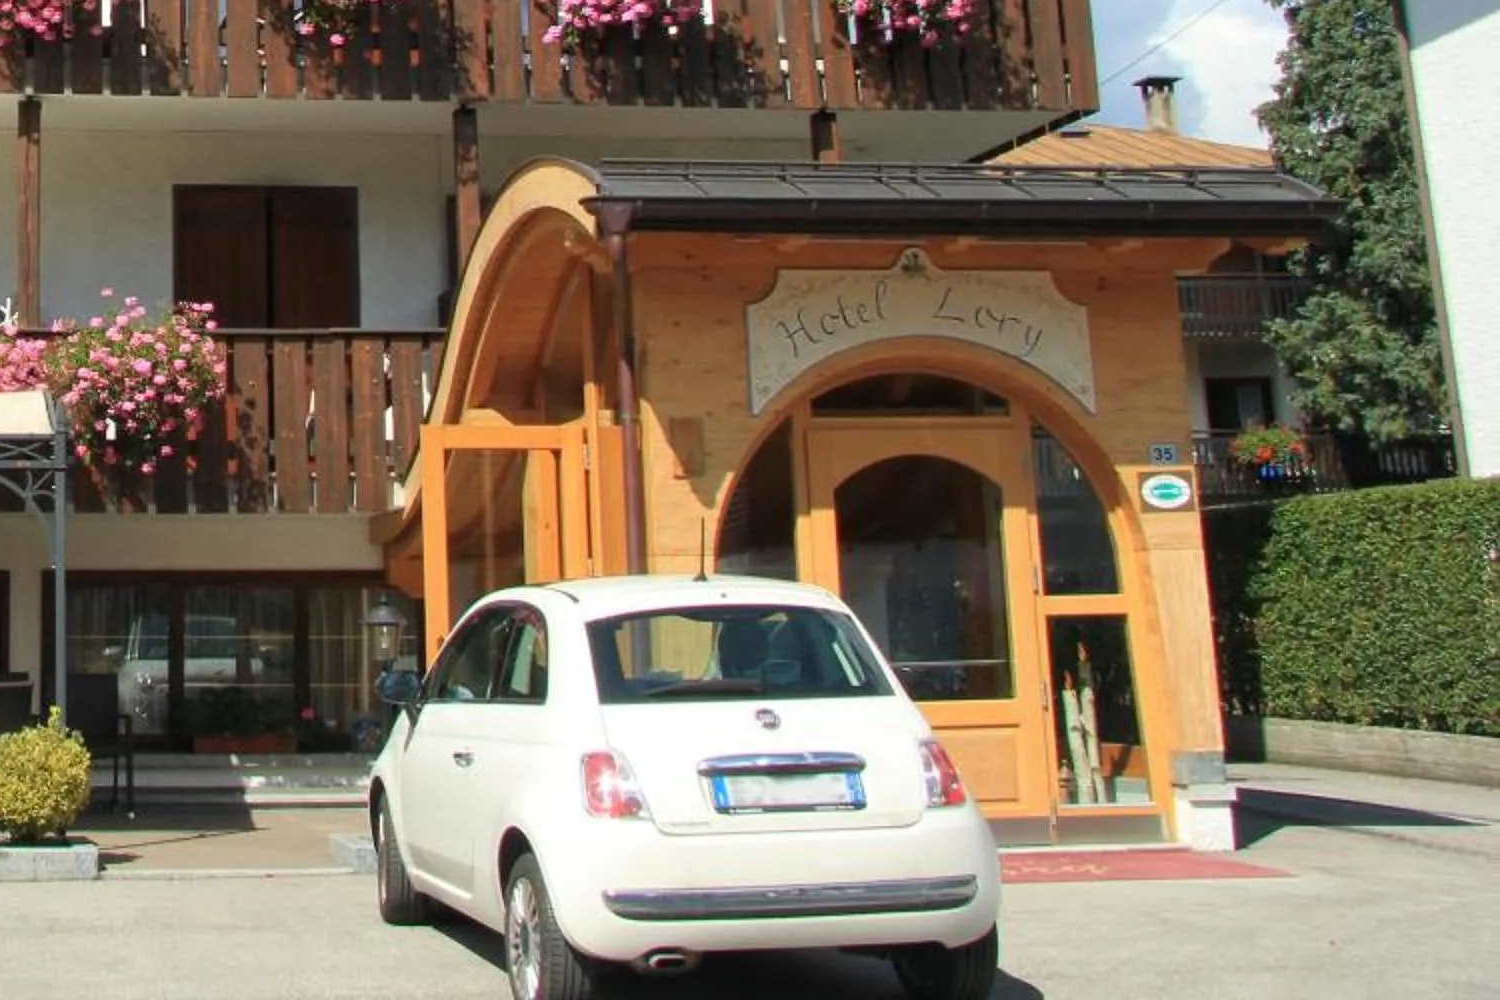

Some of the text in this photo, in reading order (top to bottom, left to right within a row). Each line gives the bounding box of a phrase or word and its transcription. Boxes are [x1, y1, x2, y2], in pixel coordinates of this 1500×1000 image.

[776, 280, 1044, 357] Hotel Lory
[1153, 447, 1174, 461] 35
